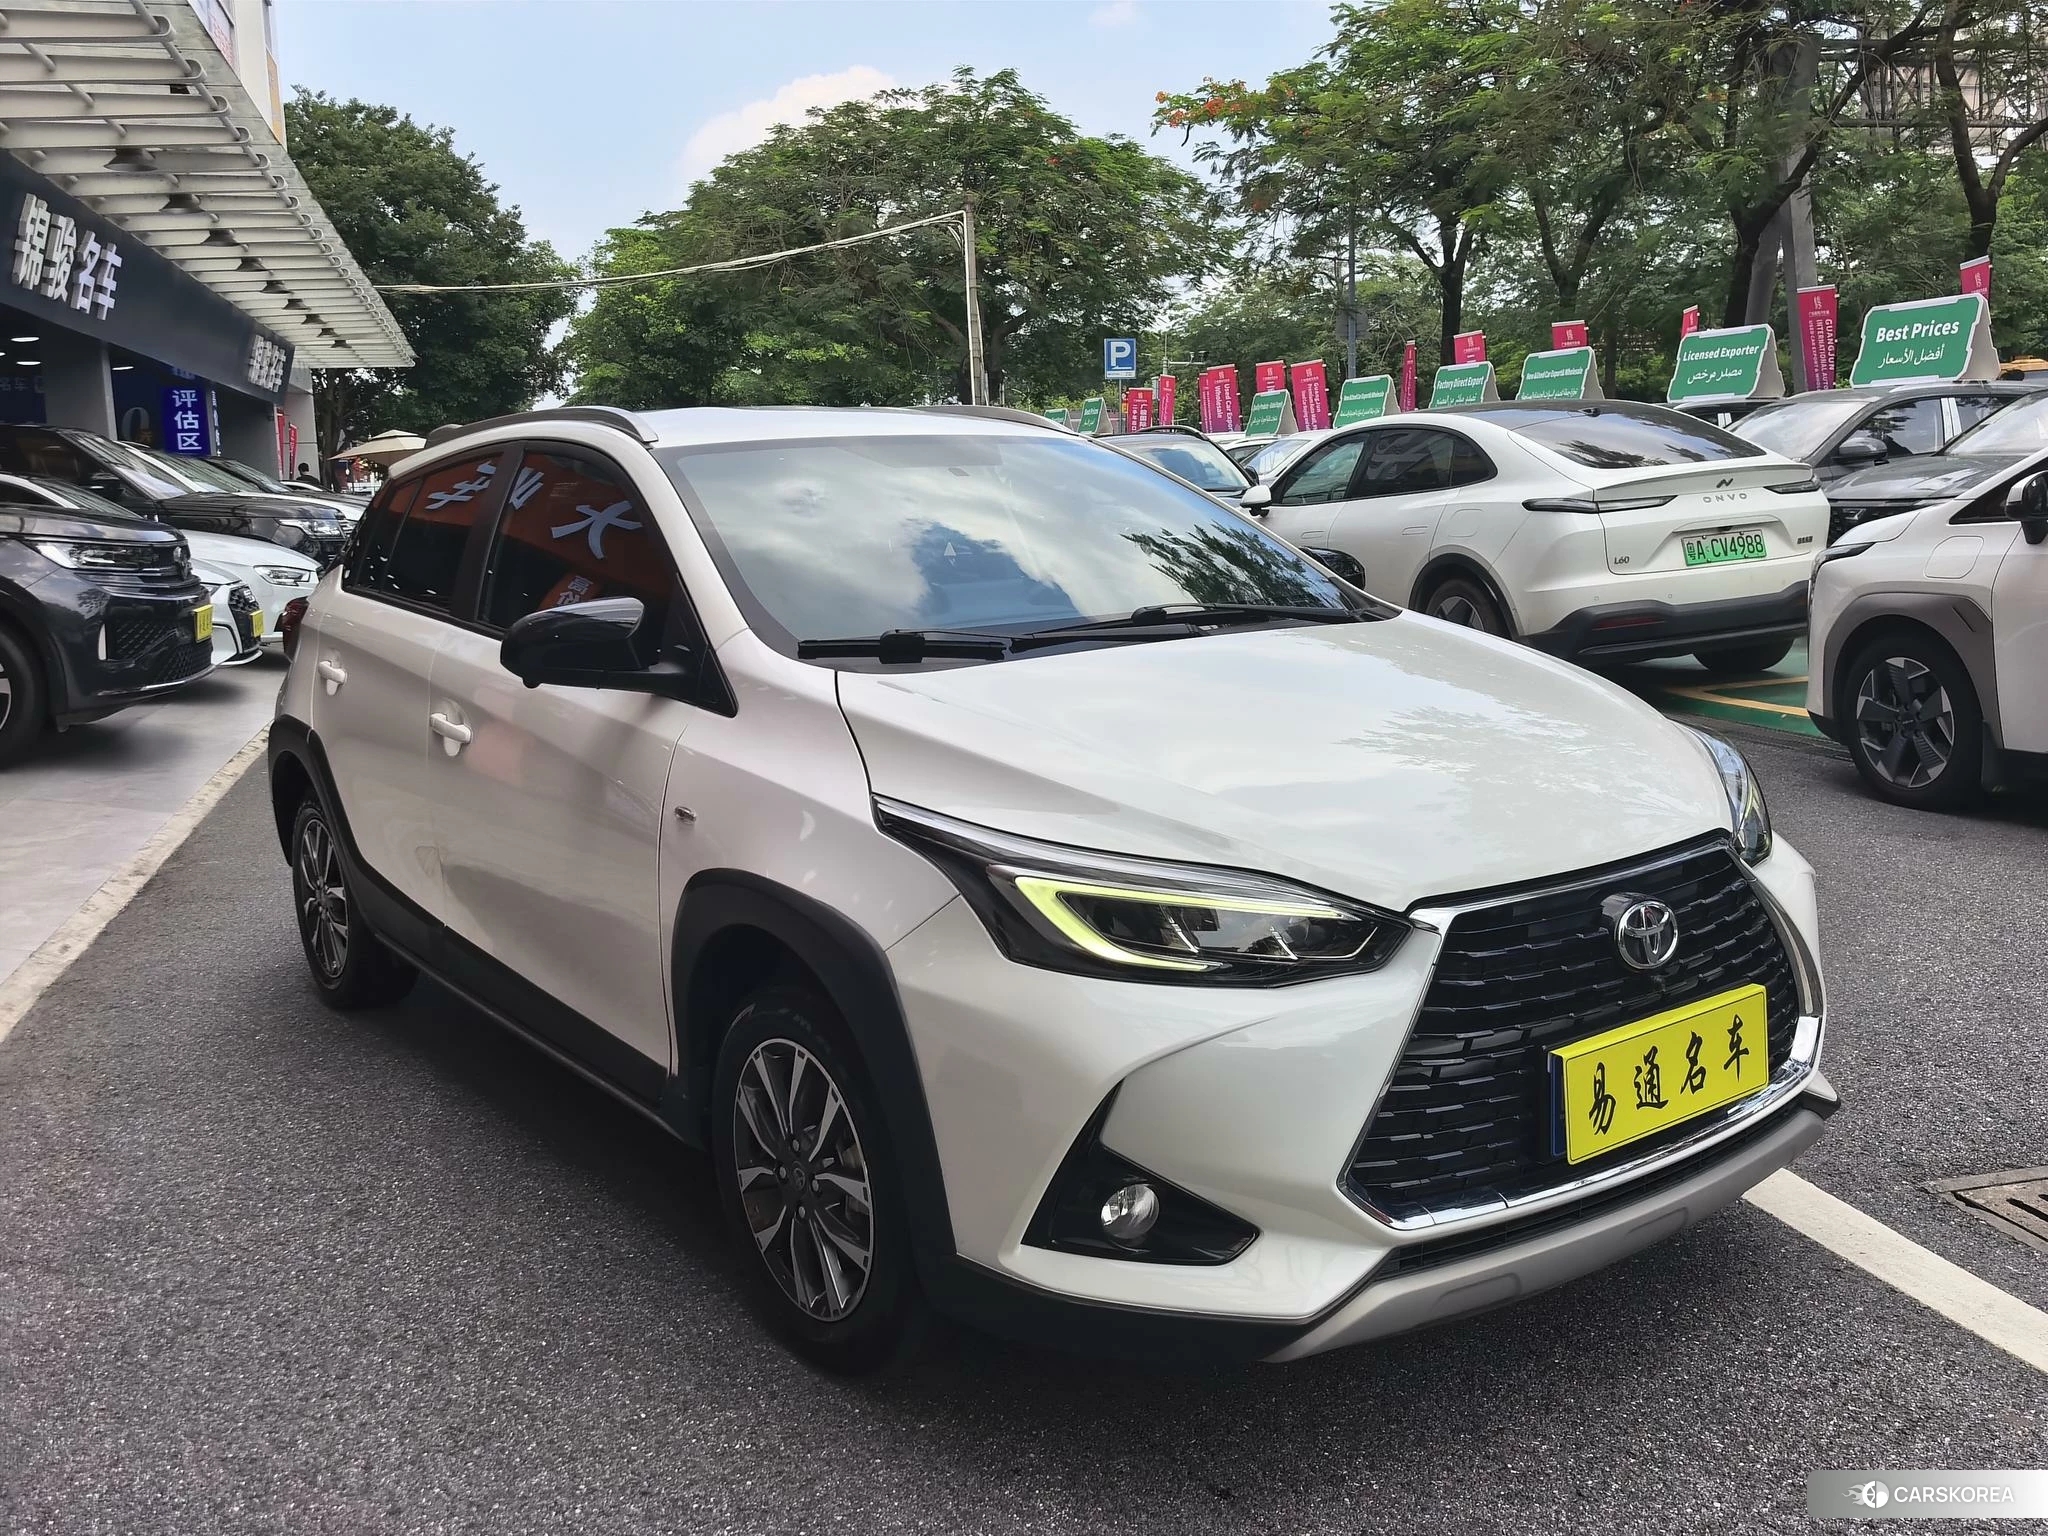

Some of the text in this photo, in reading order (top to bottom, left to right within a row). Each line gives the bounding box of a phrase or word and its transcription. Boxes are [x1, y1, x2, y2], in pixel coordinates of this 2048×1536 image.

[12, 193, 122, 320] 锦骏名车
[1875, 320, 1960, 343] Best Prices
[1110, 341, 1131, 366] P
[1682, 344, 1760, 362] Licensed Exporter
[1825, 318, 1835, 371] GUANGJUN
[1877, 343, 1945, 369] أفضل الأسعار
[1437, 376, 1484, 391] Factory Direct Export
[1215, 385, 1223, 419] Wholesale
[172, 390, 202, 450] 评估区
[1226, 412, 1234, 432] Expor
[1702, 493, 1748, 503] ONVO
[1711, 534, 1764, 557] CV4988
[1614, 556, 1630, 565] L60
[1589, 1014, 1749, 1136] 易通名车
